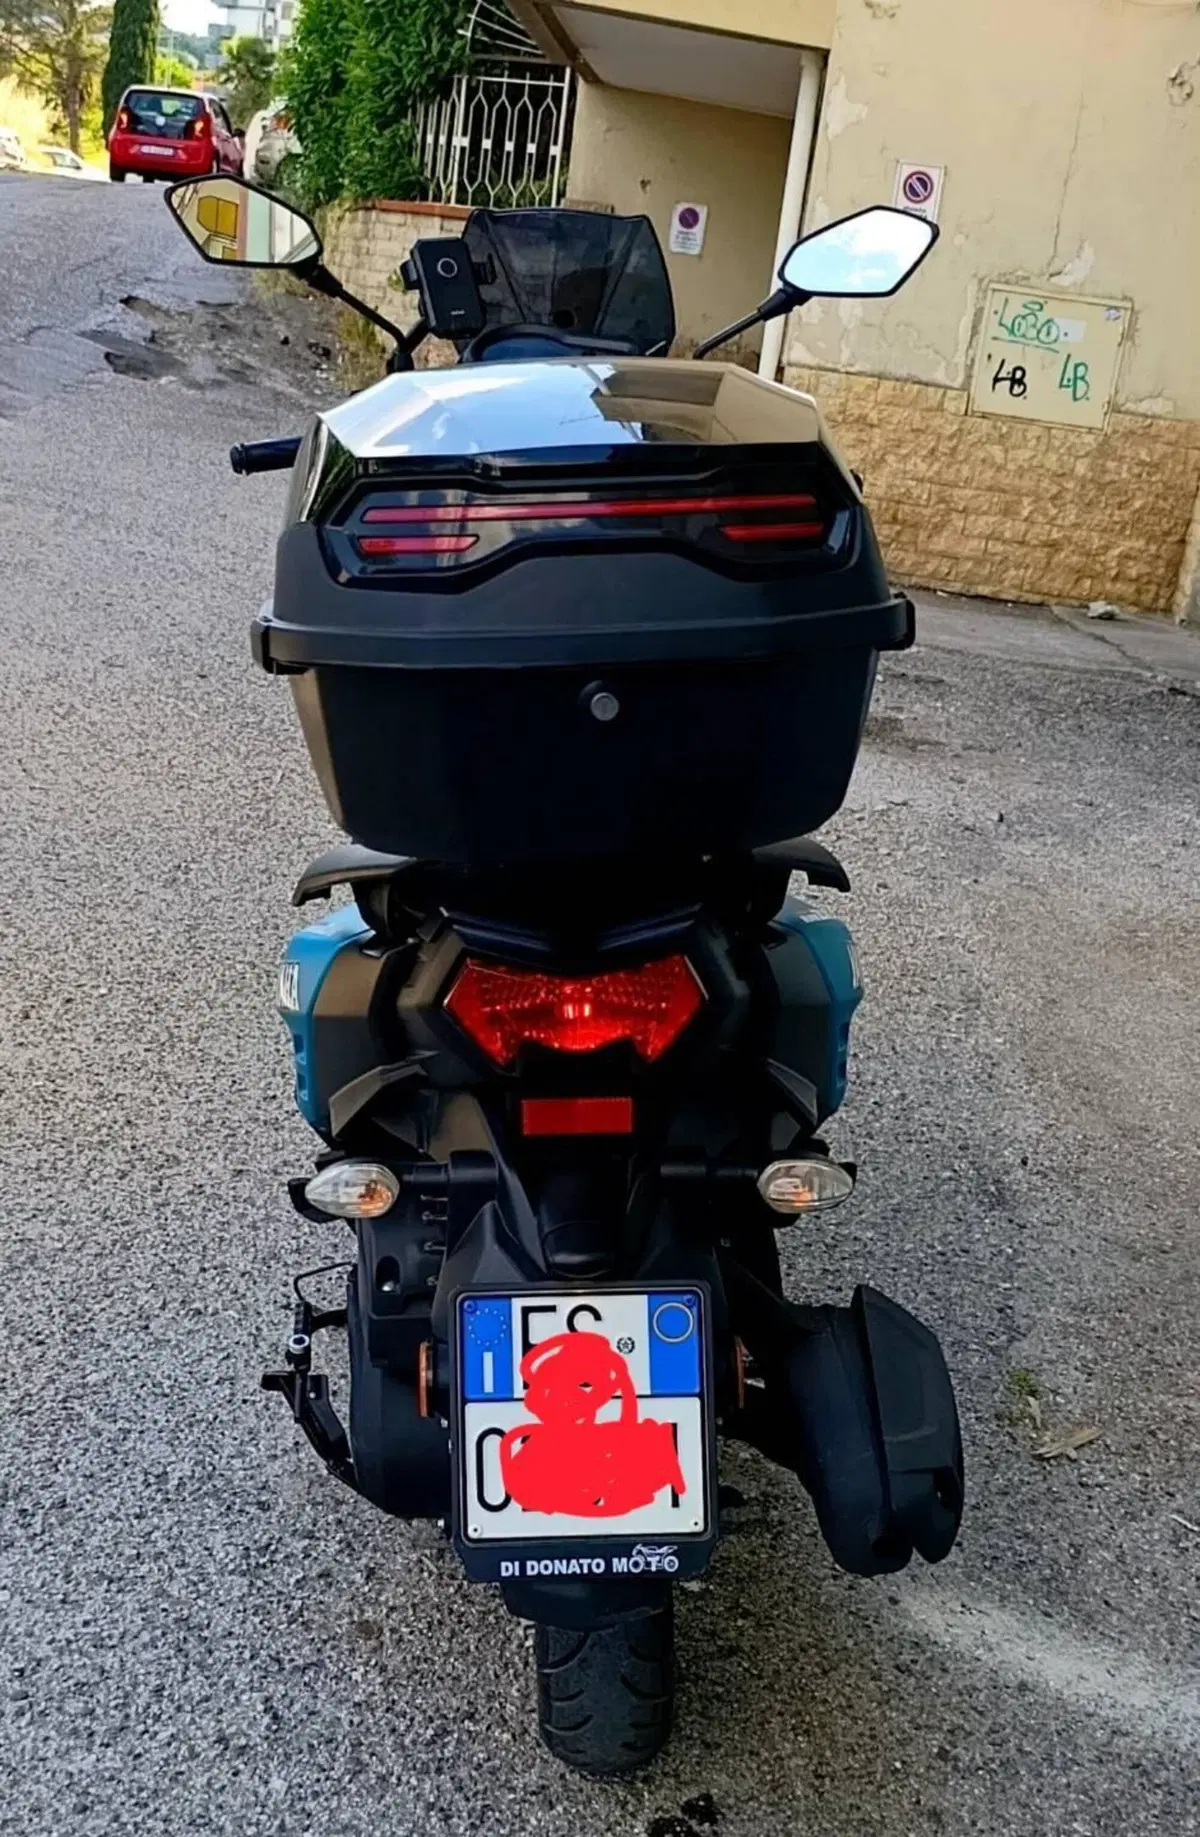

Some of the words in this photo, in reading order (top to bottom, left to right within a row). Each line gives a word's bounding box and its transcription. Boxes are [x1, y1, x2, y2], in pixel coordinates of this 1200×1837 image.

[500, 1561, 520, 1577] DI
[526, 1558, 605, 1576] DONATO
[612, 1556, 679, 1573] MOTO
